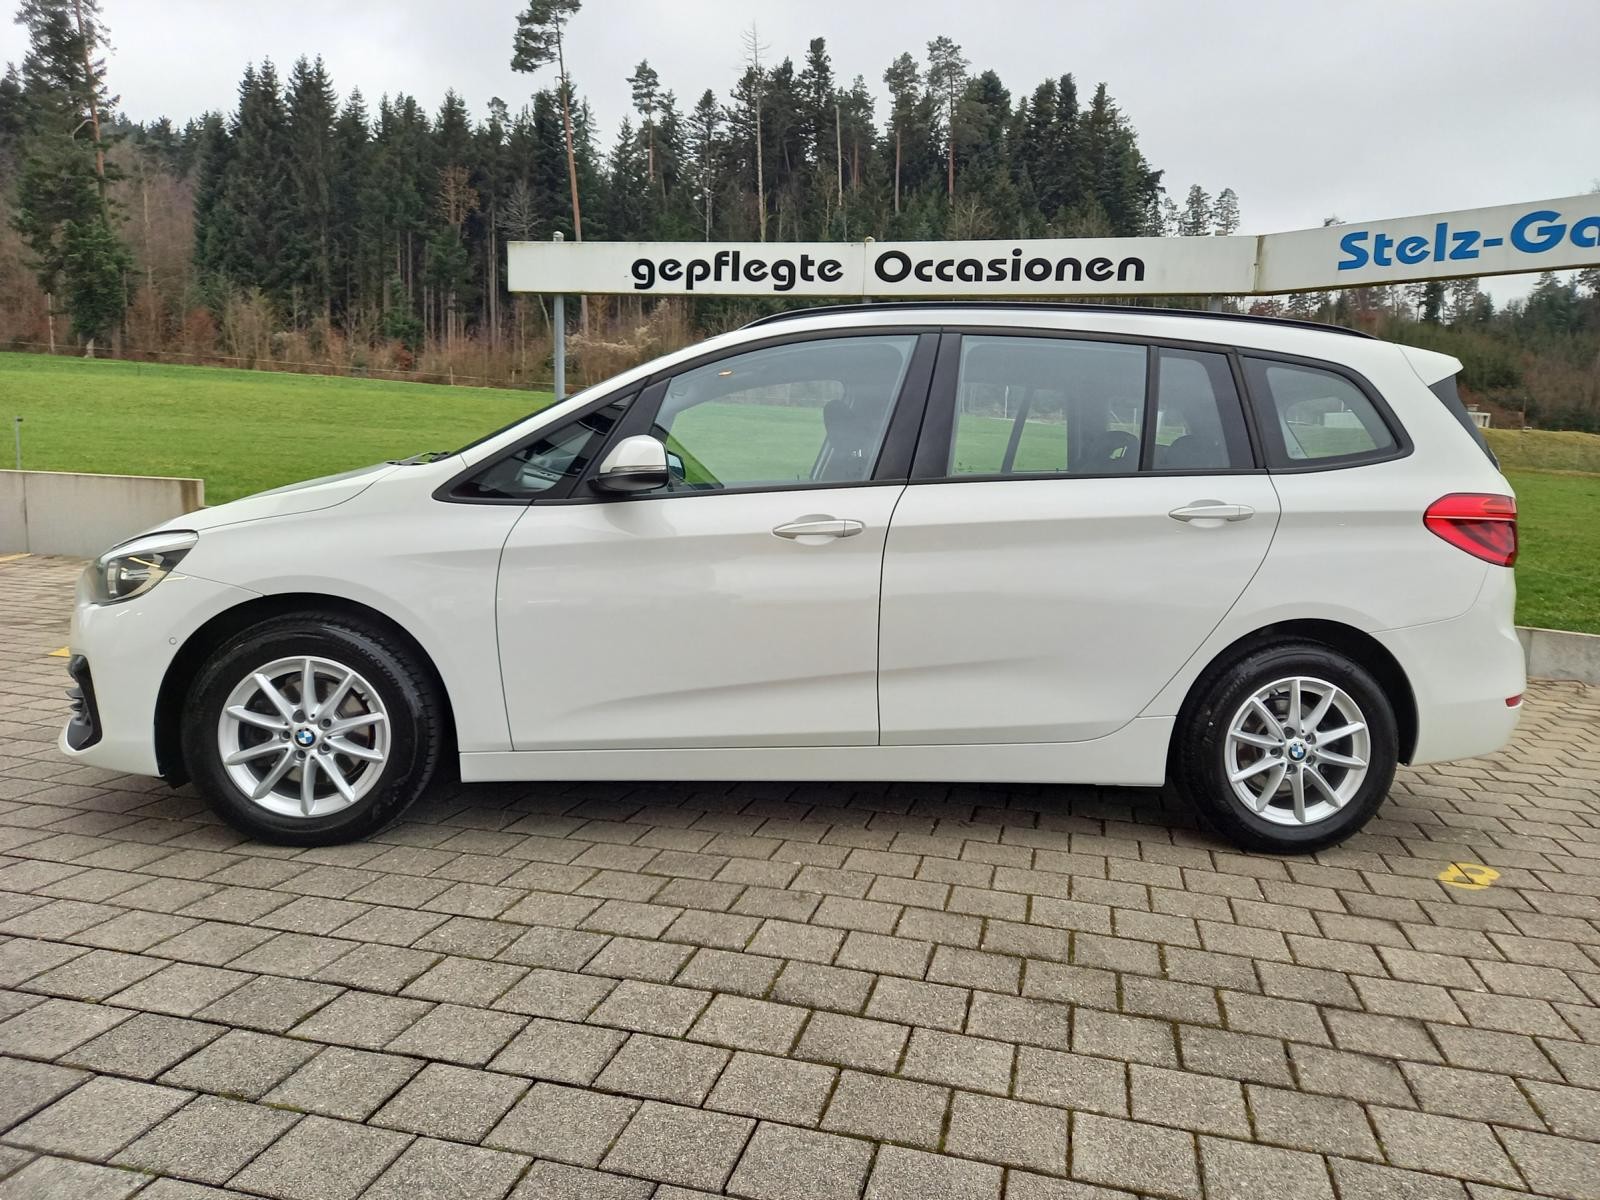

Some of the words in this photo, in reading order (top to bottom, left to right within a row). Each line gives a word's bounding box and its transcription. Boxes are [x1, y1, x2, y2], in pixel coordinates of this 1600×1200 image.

[1337, 210, 1600, 271] Stelz-Ga
[631, 250, 844, 292] gepflegte
[874, 247, 1145, 282] Occasionen
